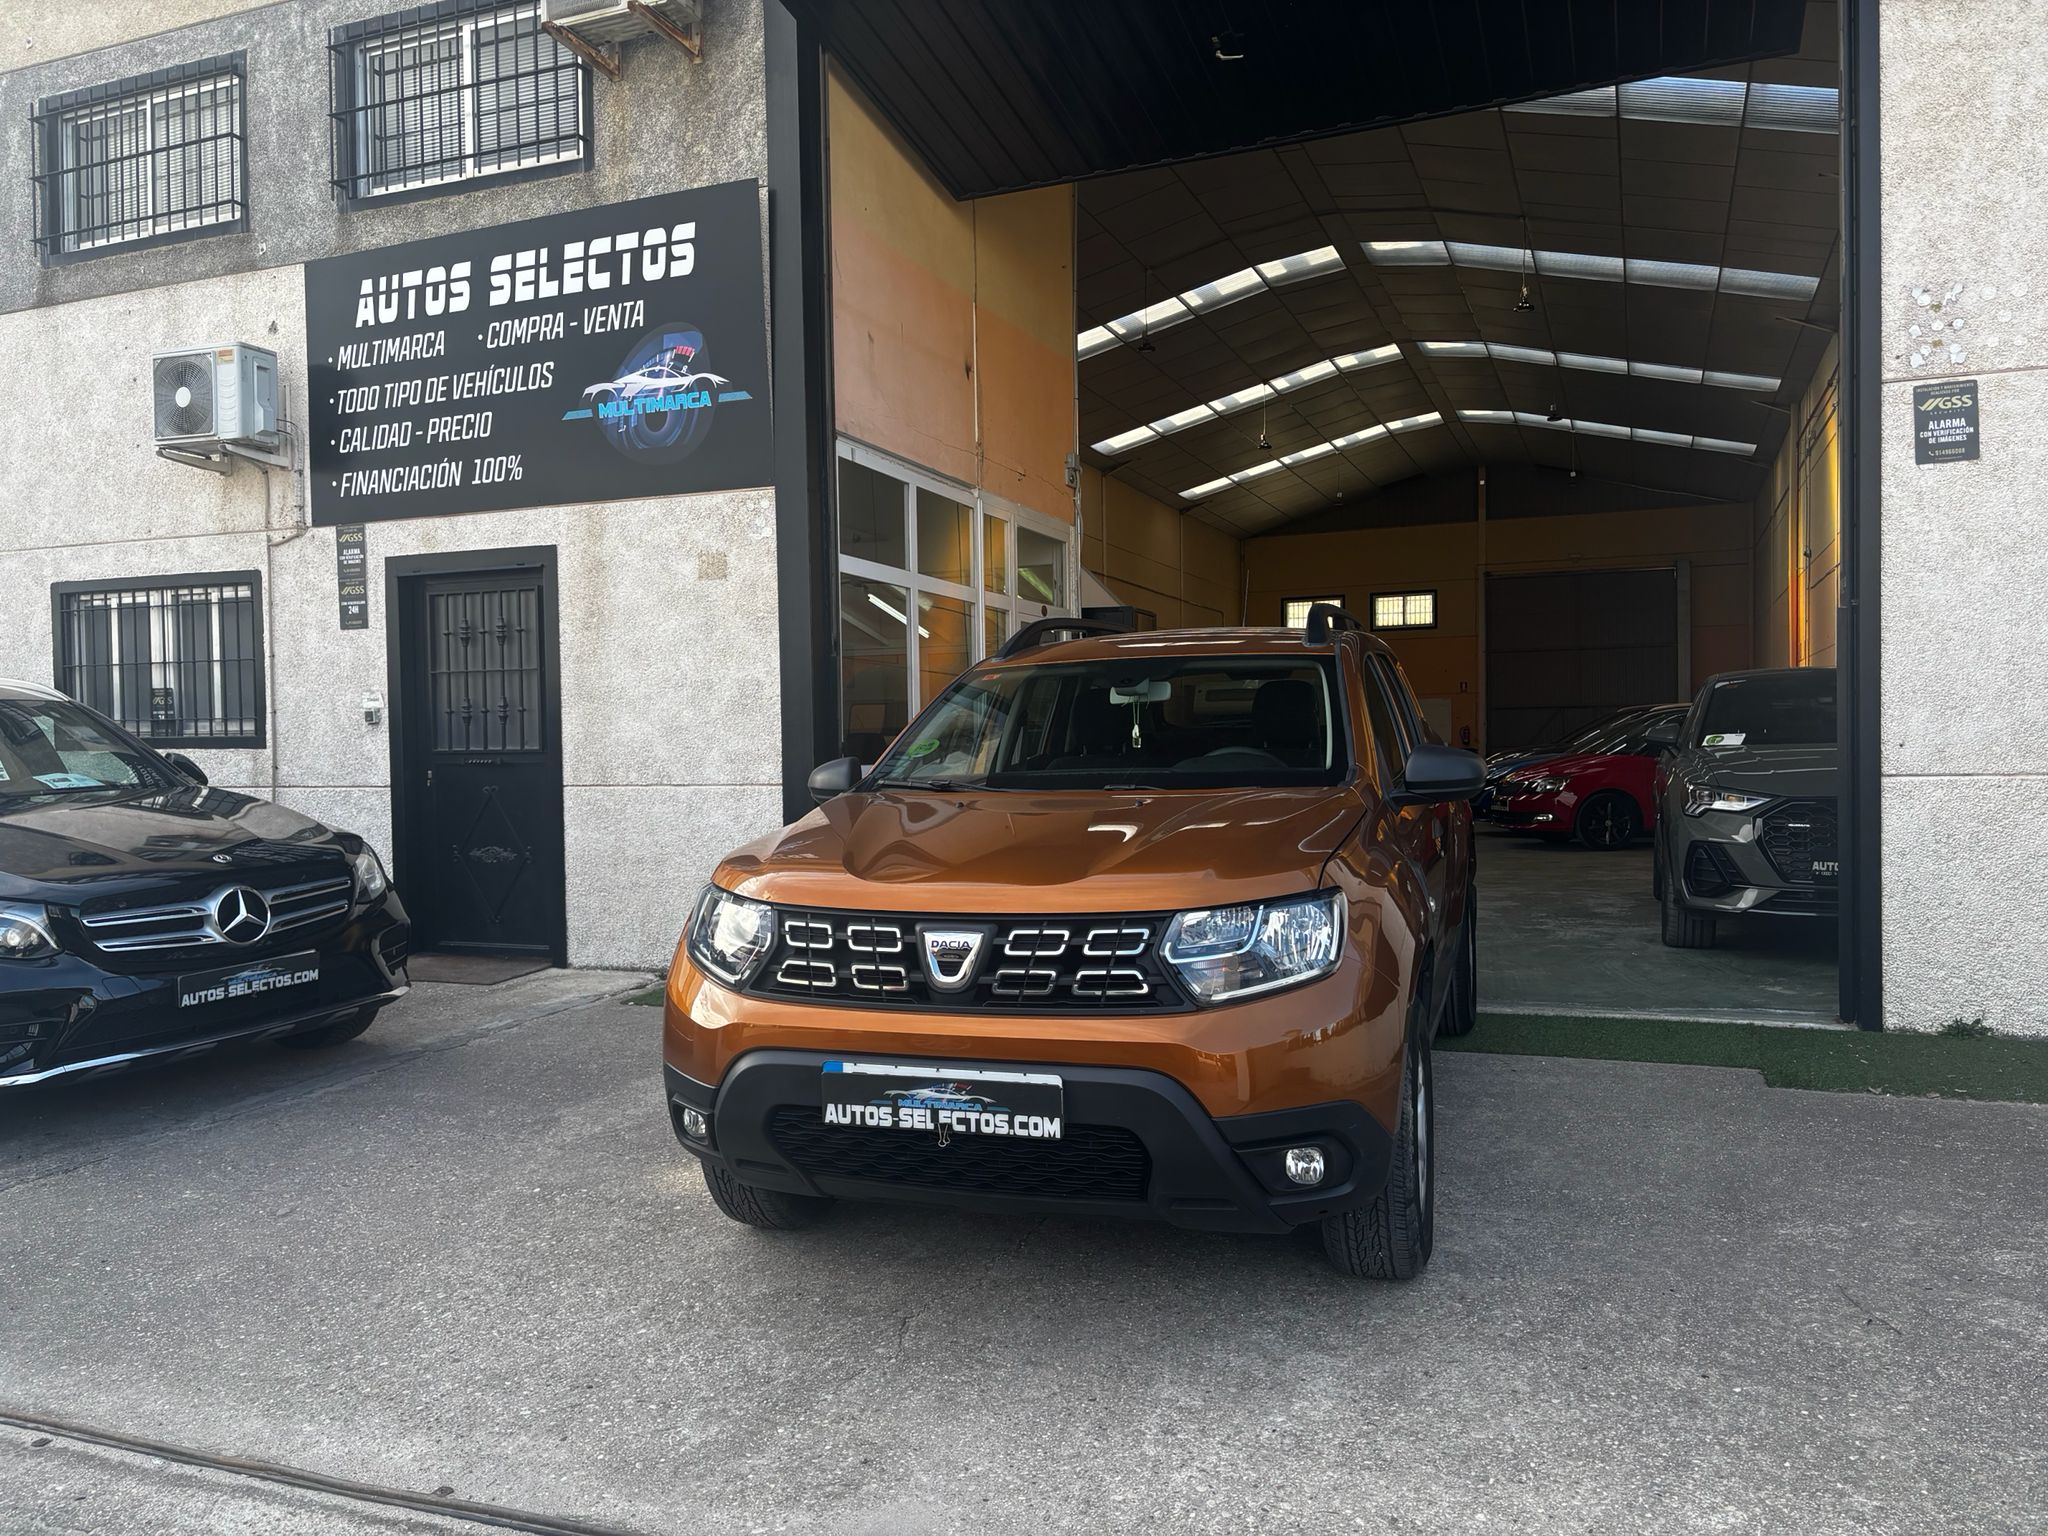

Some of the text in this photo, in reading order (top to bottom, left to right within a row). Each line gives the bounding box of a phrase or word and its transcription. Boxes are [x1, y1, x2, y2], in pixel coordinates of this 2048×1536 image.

[354, 221, 697, 328] AUTOS SELECTOS
[486, 312, 564, 349] COMPRA
[583, 299, 645, 335] VENTA
[337, 330, 446, 371] MULTIMARCA
[337, 360, 555, 415] TODO TIPO DE VEHÍCULOS
[598, 390, 713, 420] MULTIMARCA
[1938, 394, 1973, 409] GSS
[339, 419, 412, 455] CALIDAD
[426, 410, 493, 445] PRECIO
[1928, 417, 1966, 430] ALARMA
[1933, 426, 1975, 437] VERIFICACIÓN
[1938, 434, 1967, 443] IMÁGENES
[340, 454, 523, 498] FINANCIACIÓN 100%
[930, 939, 972, 950] DACIA
[181, 968, 319, 1008] AUTOS-SELECTOS.COM
